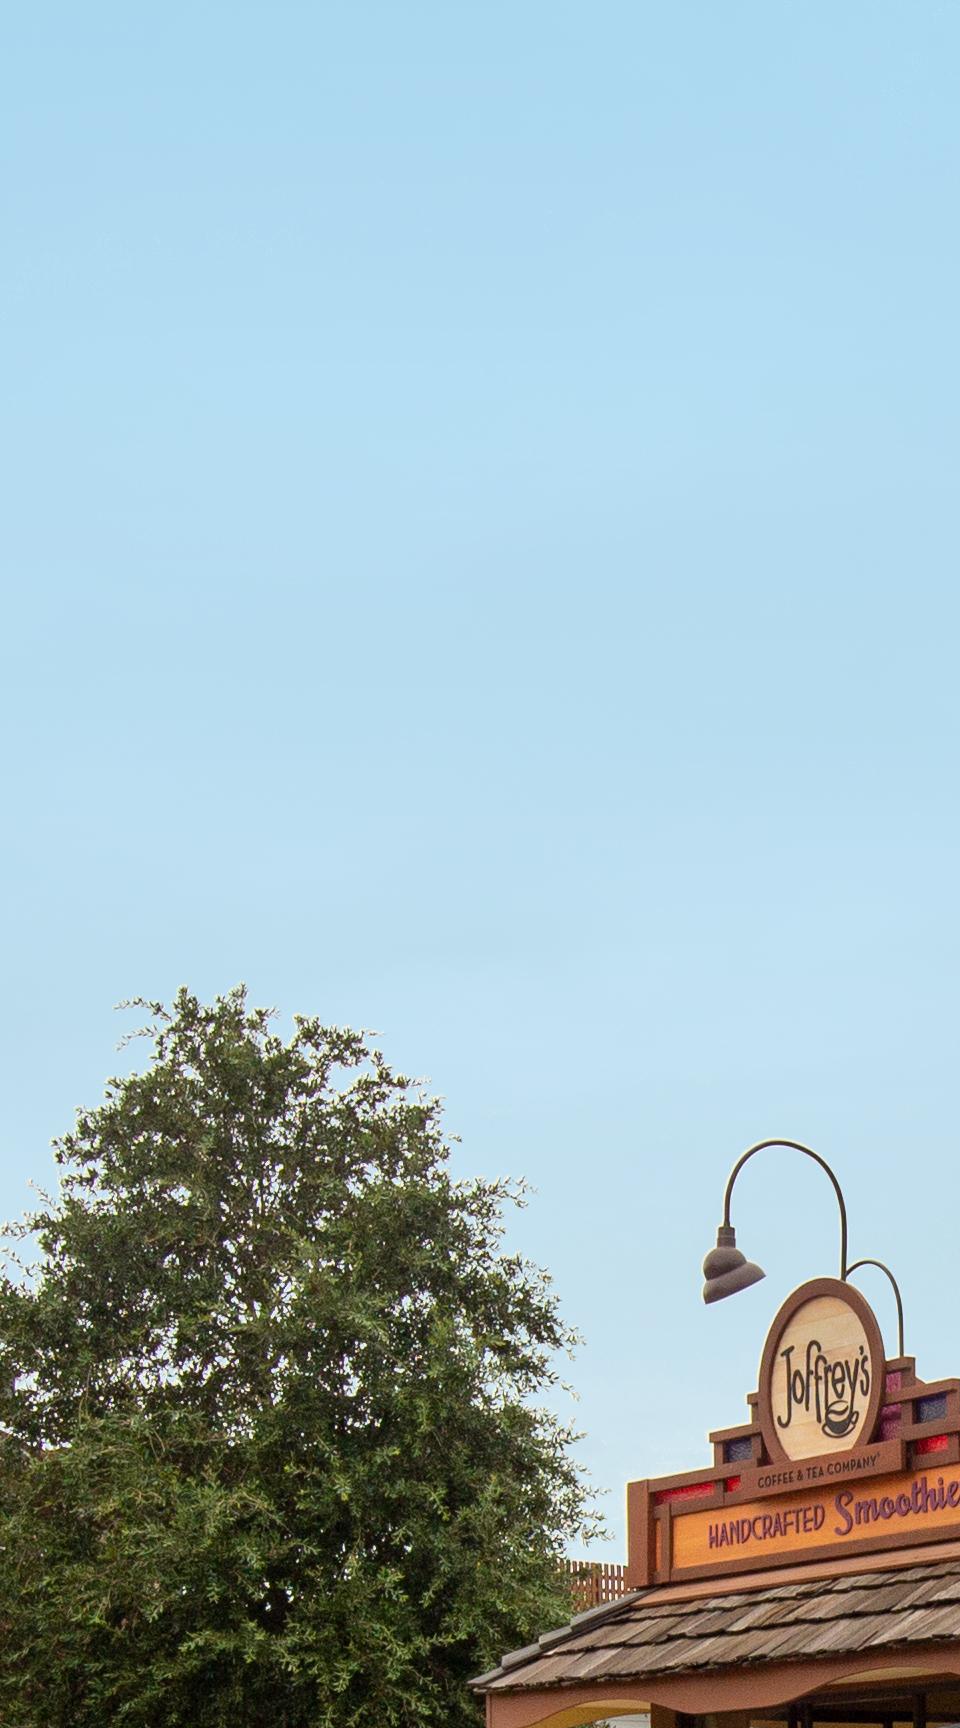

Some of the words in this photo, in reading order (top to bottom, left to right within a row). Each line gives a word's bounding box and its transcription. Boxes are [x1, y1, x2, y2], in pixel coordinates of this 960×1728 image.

[776, 1339, 870, 1429] Joffrey's
[757, 1470, 794, 1489] COFFEE
[796, 1468, 804, 1481] &
[806, 1465, 825, 1479] TEA
[708, 1503, 826, 1549] HANDCRAFTED
